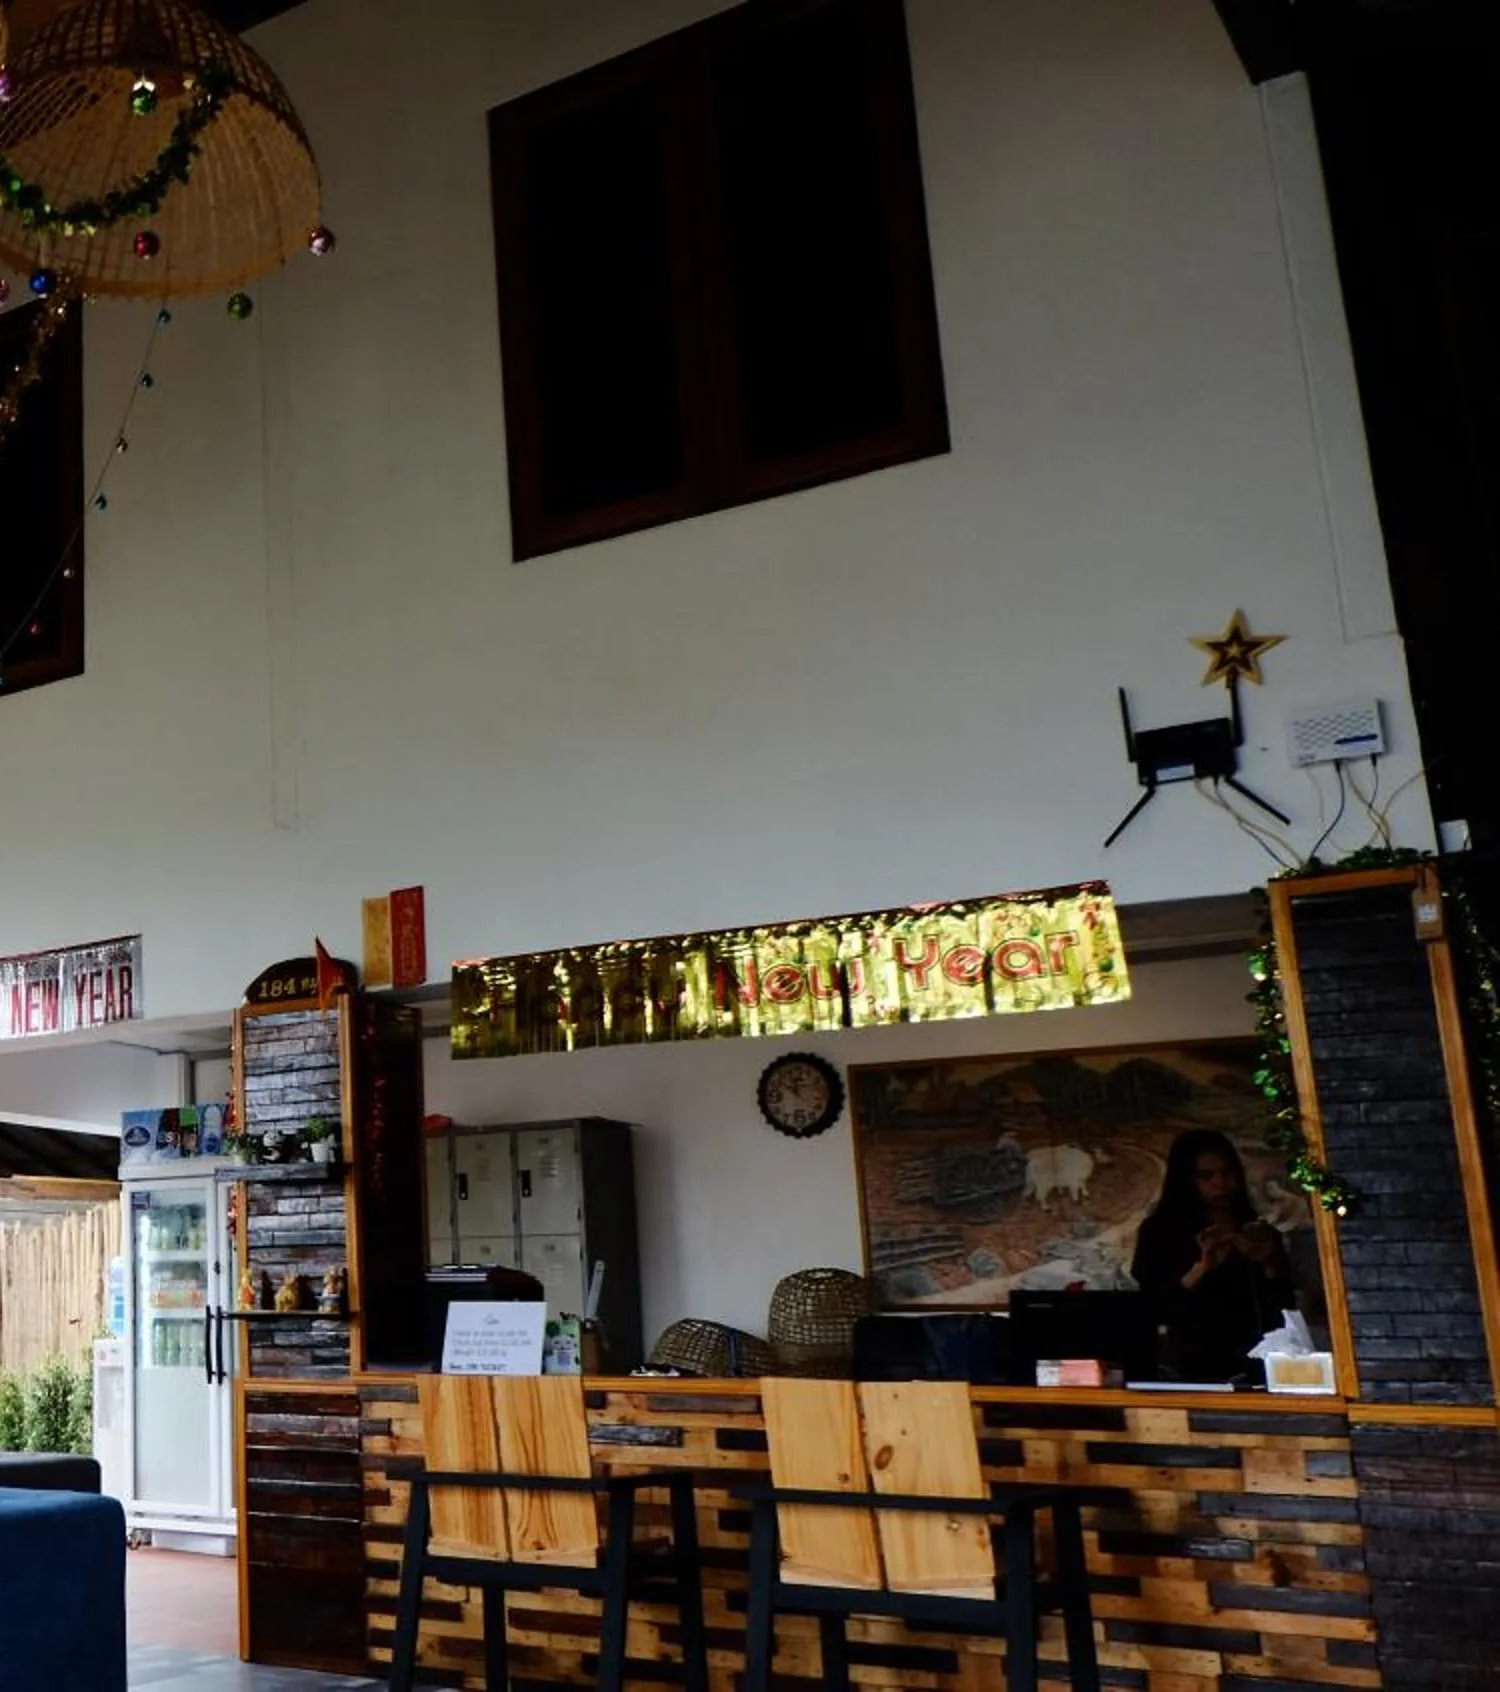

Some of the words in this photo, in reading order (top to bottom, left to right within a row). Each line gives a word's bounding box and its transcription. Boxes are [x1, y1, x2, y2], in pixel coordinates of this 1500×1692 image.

[10, 977, 60, 1035] NEW
[74, 965, 133, 1026] YEAR
[258, 977, 297, 997] 184
[714, 957, 863, 1007] New
[892, 929, 1078, 991] Year
